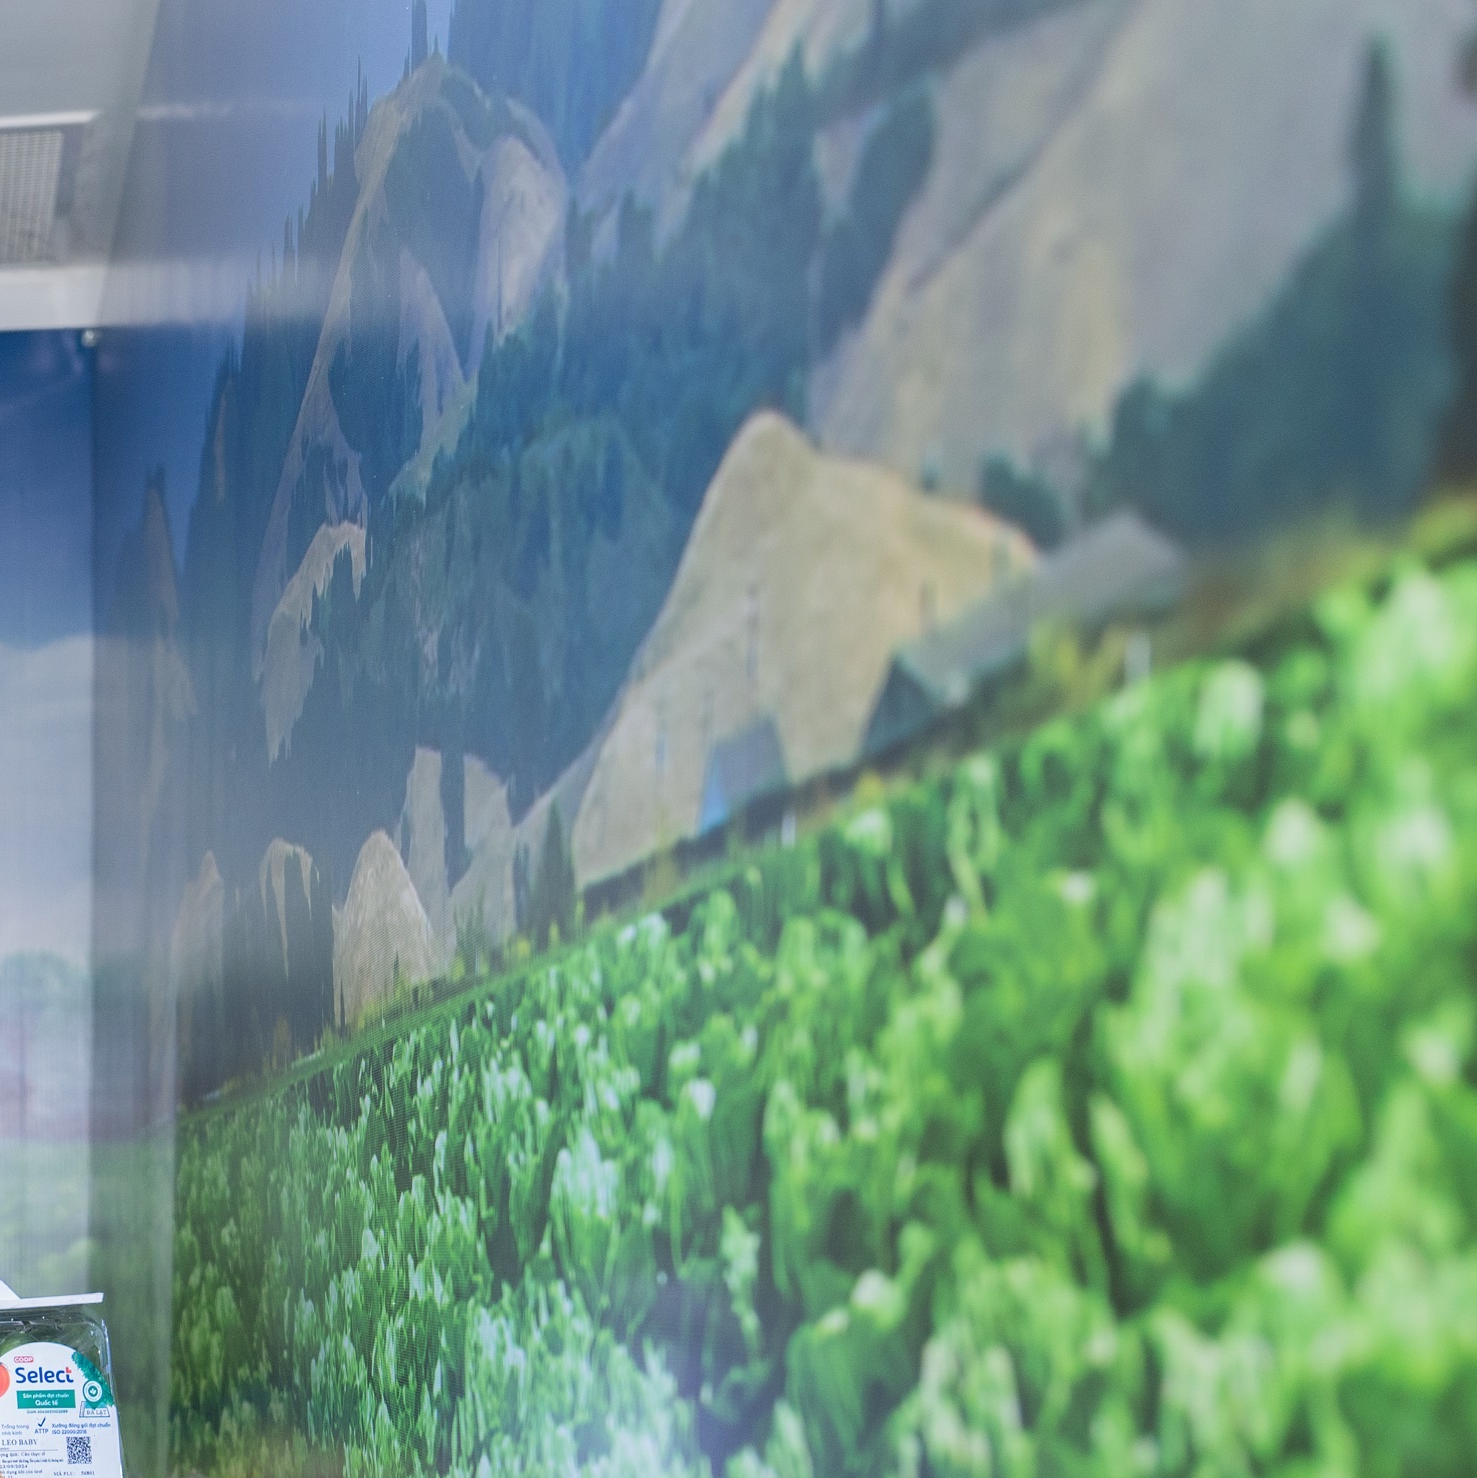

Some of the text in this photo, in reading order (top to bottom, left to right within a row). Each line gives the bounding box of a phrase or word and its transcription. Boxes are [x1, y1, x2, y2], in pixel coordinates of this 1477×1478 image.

[15, 1366, 74, 1383] Select
[35, 1399, 51, 1407] Quốc
[19, 1438, 38, 1446] BABY
